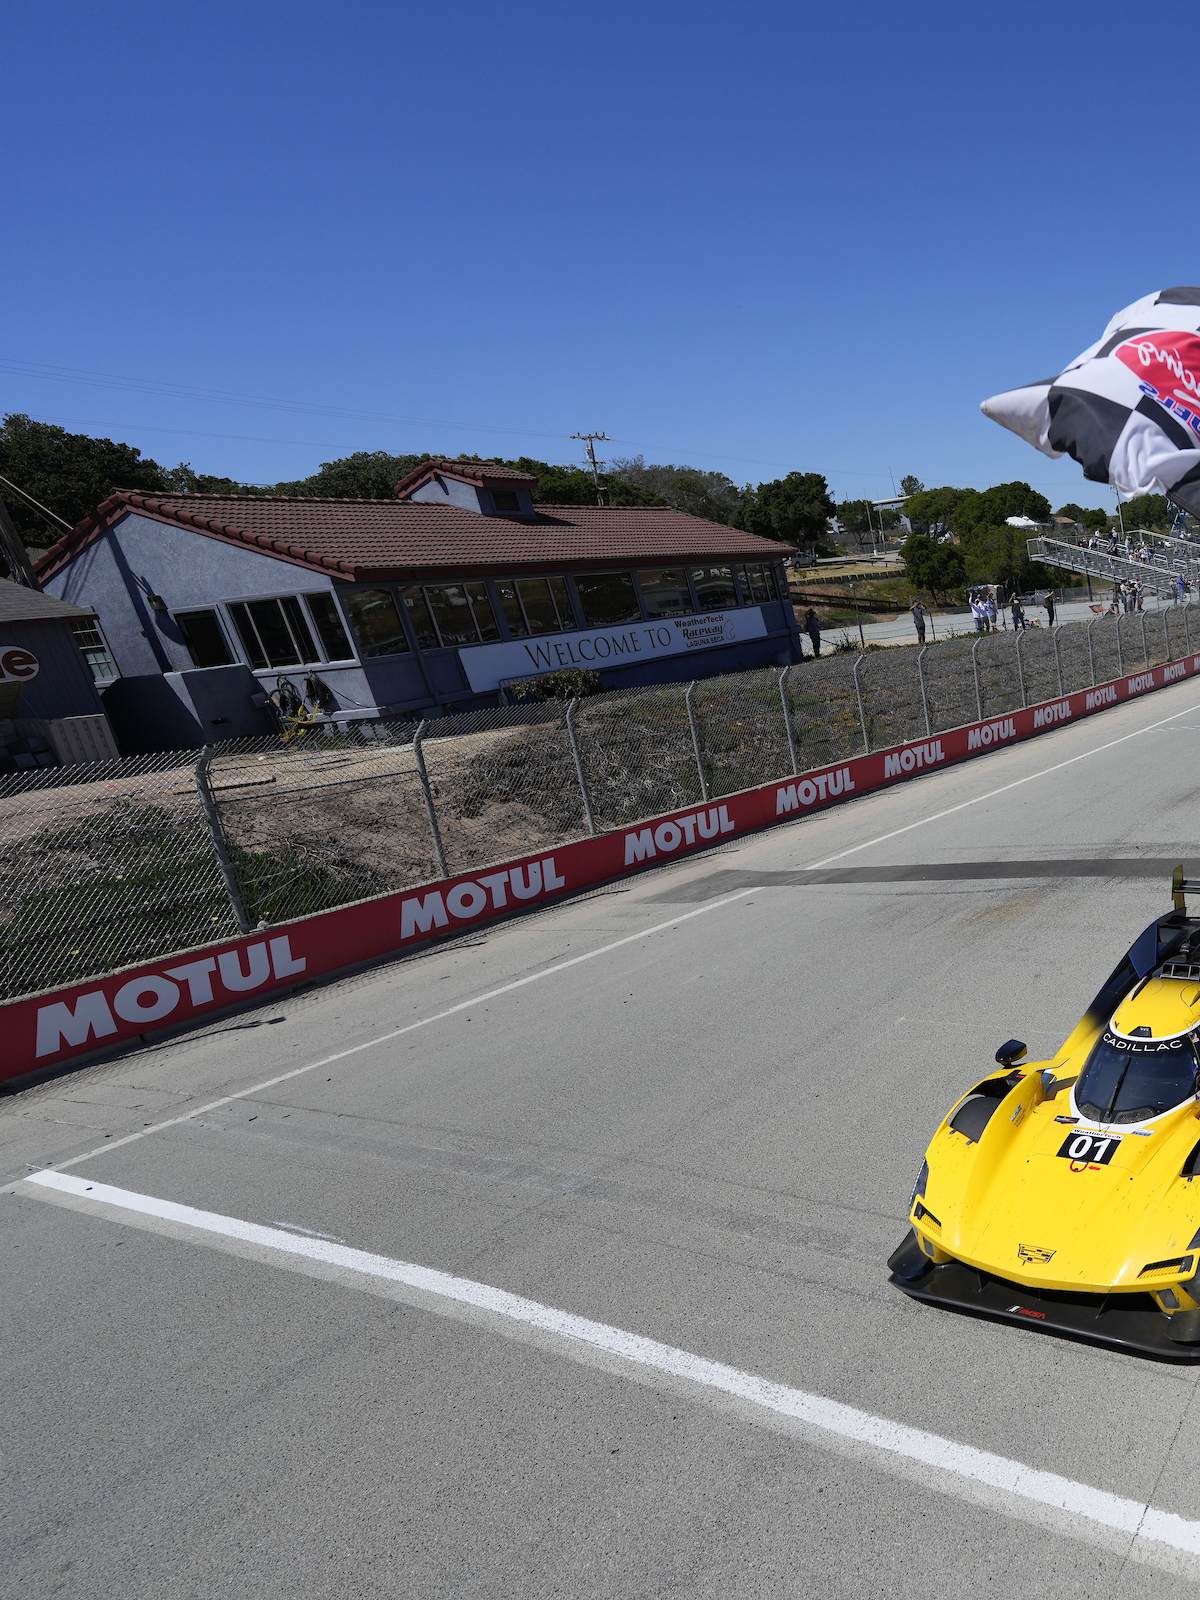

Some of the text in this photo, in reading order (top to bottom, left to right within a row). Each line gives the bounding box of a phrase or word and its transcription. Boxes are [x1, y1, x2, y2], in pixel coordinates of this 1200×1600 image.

[674, 615, 724, 628] WeatherTech
[682, 626, 723, 640] Raceway
[524, 627, 671, 670] WELCOME TO
[686, 636, 725, 648] LAGUNA SECA
[1129, 673, 1154, 694] MOTUL
[1164, 662, 1186, 682] MOTUL
[1086, 685, 1117, 710] MOTUL
[1034, 701, 1072, 728] MOTUL
[968, 718, 1016, 750] MOTUL
[884, 740, 946, 778] MOTUL
[776, 767, 855, 815] MOTUL
[624, 805, 735, 868] MOTUL
[400, 858, 565, 940] MOTUL
[35, 935, 306, 1059] MOTUL
[1103, 1033, 1182, 1052] CADILLAC
[1068, 1135, 1112, 1162] 01
